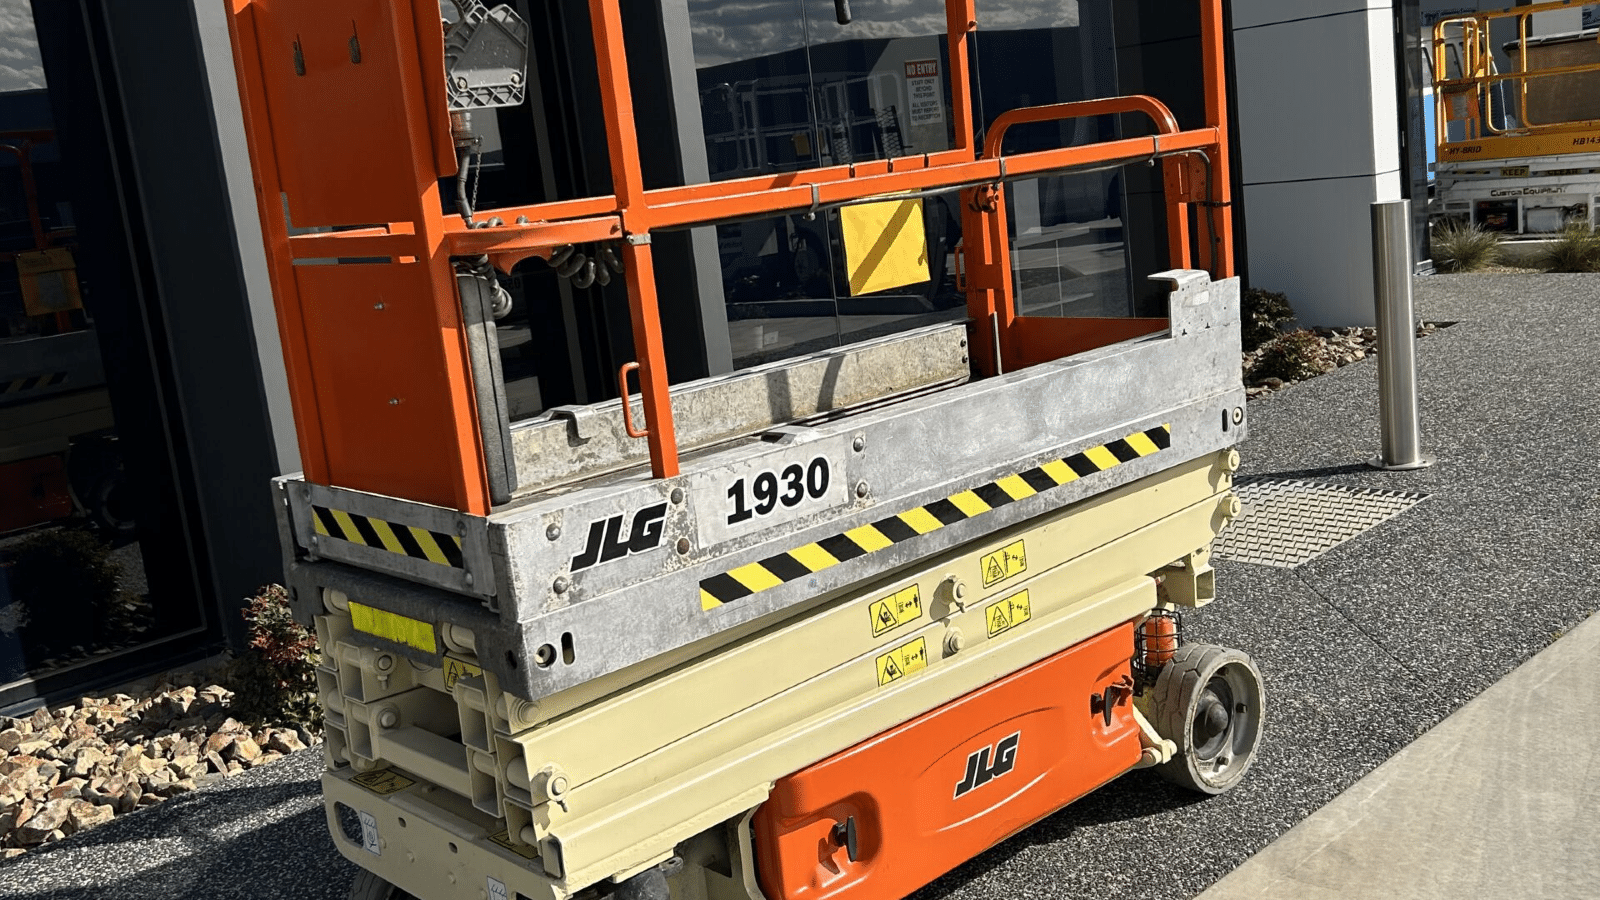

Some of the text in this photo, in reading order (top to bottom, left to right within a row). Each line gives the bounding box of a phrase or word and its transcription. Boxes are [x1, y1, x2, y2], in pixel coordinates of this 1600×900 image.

[906, 63, 936, 75] NO ENTRY
[1449, 146, 1482, 154] HY-BRID
[1502, 167, 1526, 176] KEEP
[727, 456, 830, 525] 1930
[571, 502, 668, 572] JLG
[954, 731, 1020, 798] JLG
